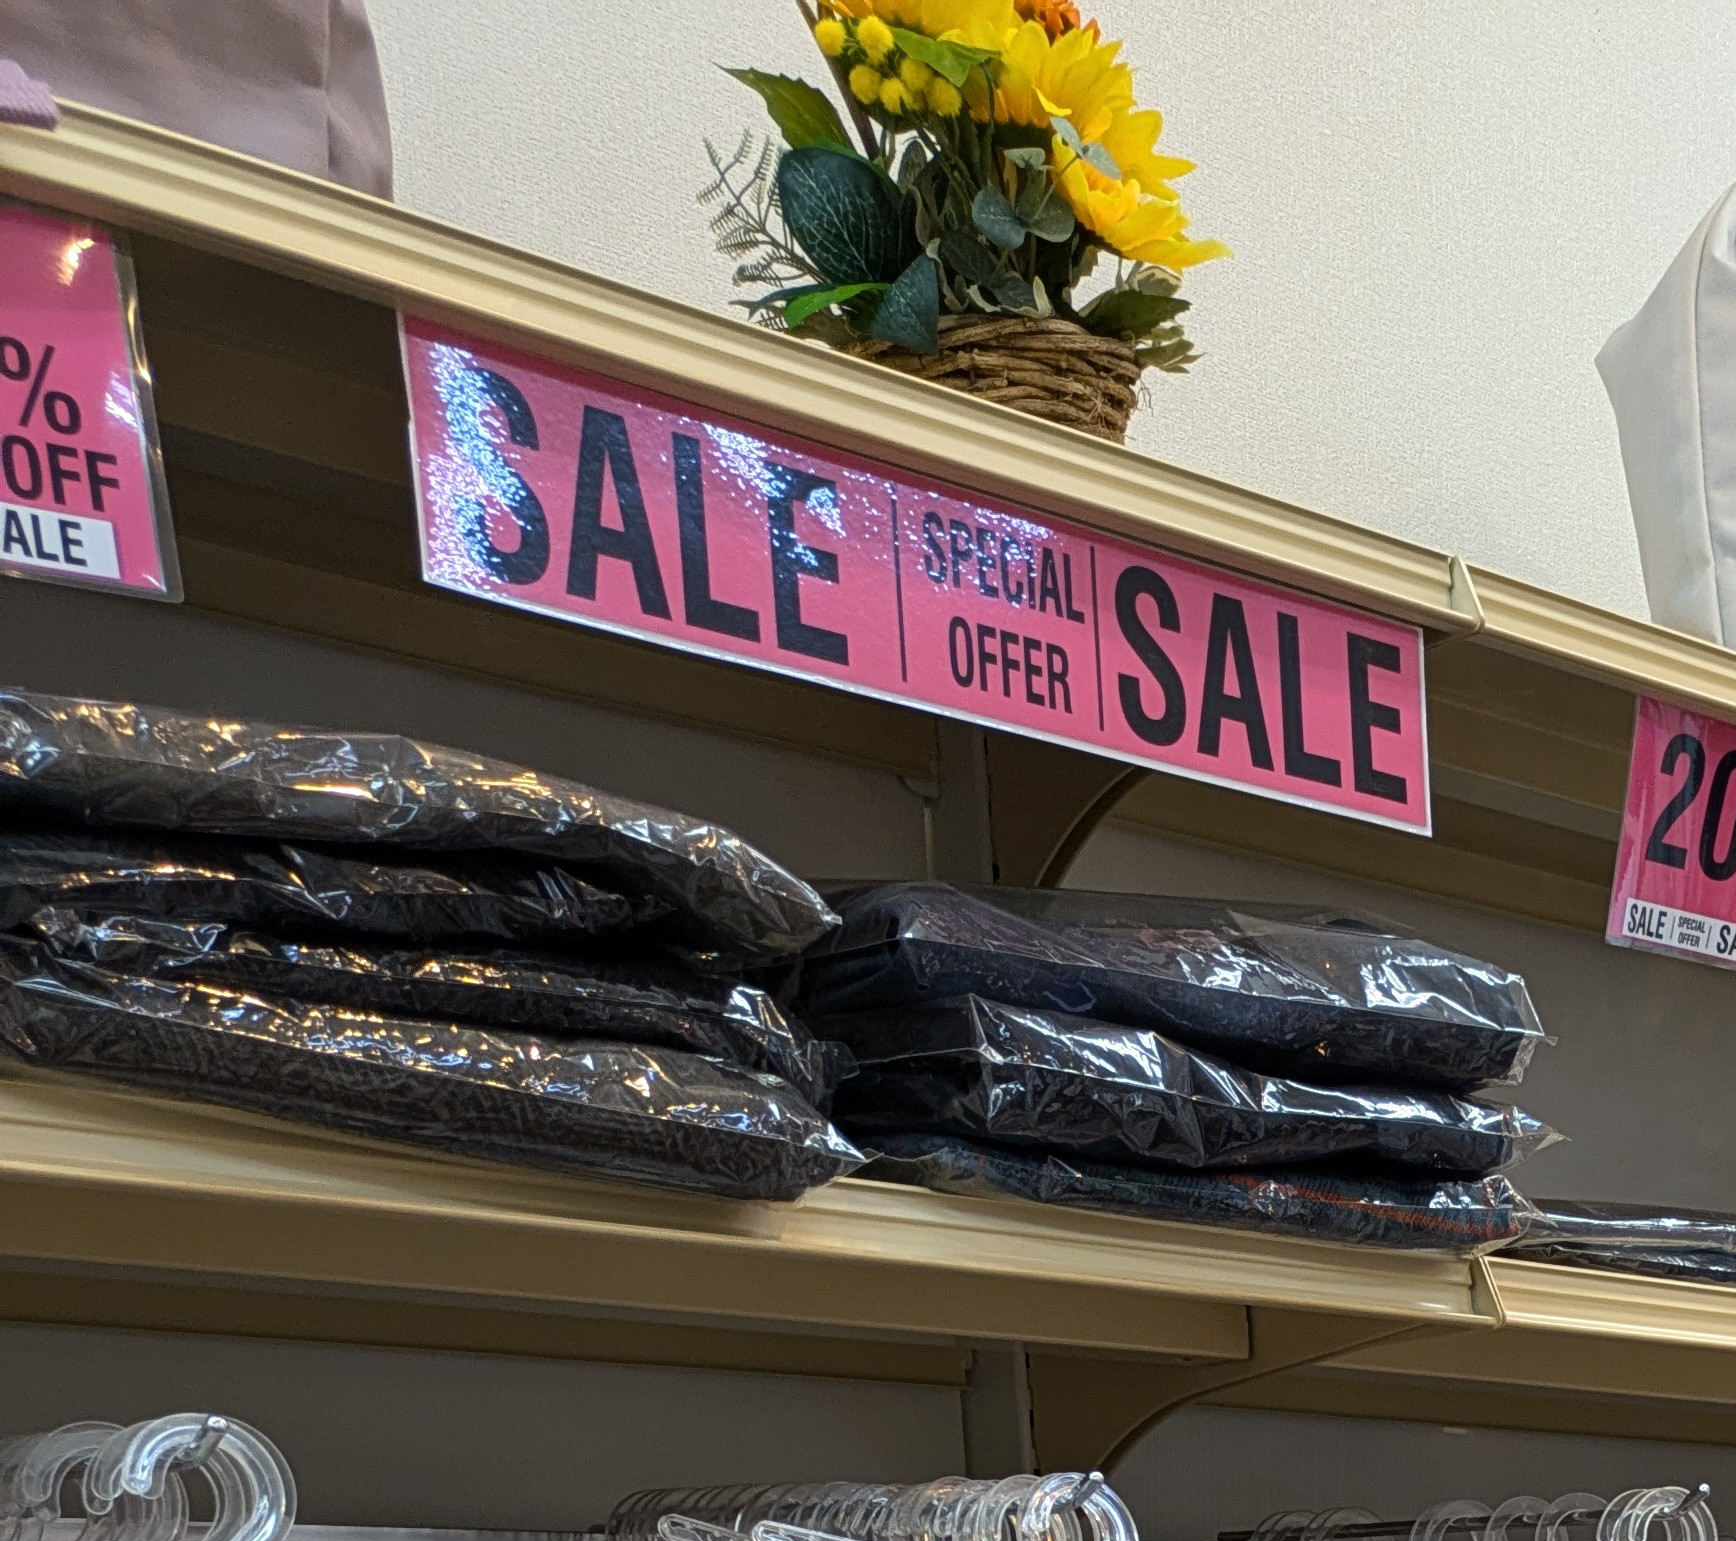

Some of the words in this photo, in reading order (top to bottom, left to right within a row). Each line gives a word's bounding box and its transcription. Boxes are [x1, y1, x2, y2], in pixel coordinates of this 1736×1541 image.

[3, 434, 119, 513] OFF
[443, 366, 849, 668] SALE
[921, 510, 1086, 625] SPECIAL
[948, 615, 1073, 715] OFFER
[1114, 565, 1408, 806] SALE
[1627, 903, 1668, 940] SALE
